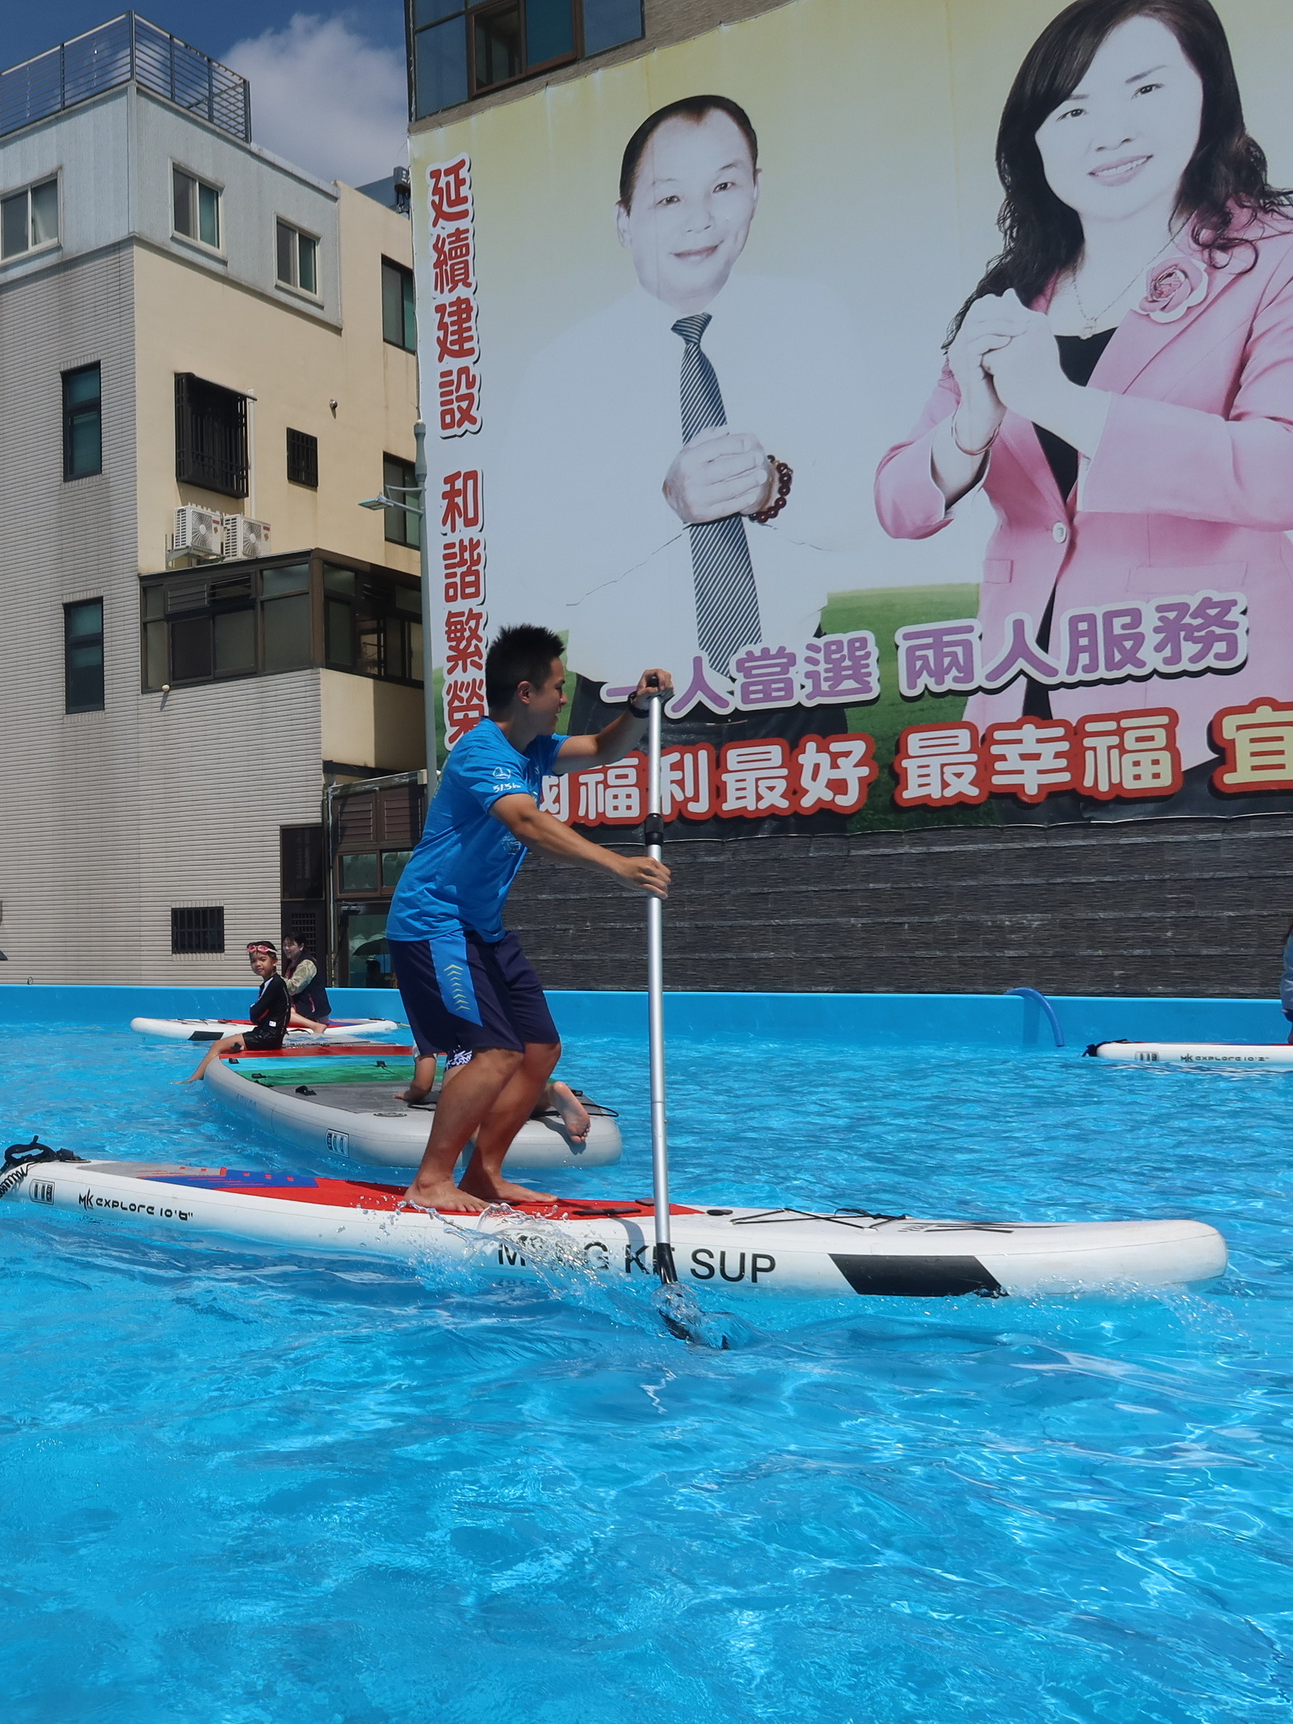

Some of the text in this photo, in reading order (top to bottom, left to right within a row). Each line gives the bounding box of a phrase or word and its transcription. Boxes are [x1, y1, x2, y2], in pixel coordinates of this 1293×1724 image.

[428, 157, 485, 744] 延續建設 和諧繁榮
[901, 596, 1239, 690] 兩人服務
[901, 715, 1173, 799] 最幸福
[1221, 705, 1293, 785] 宜
[690, 1247, 776, 1284] SUP
